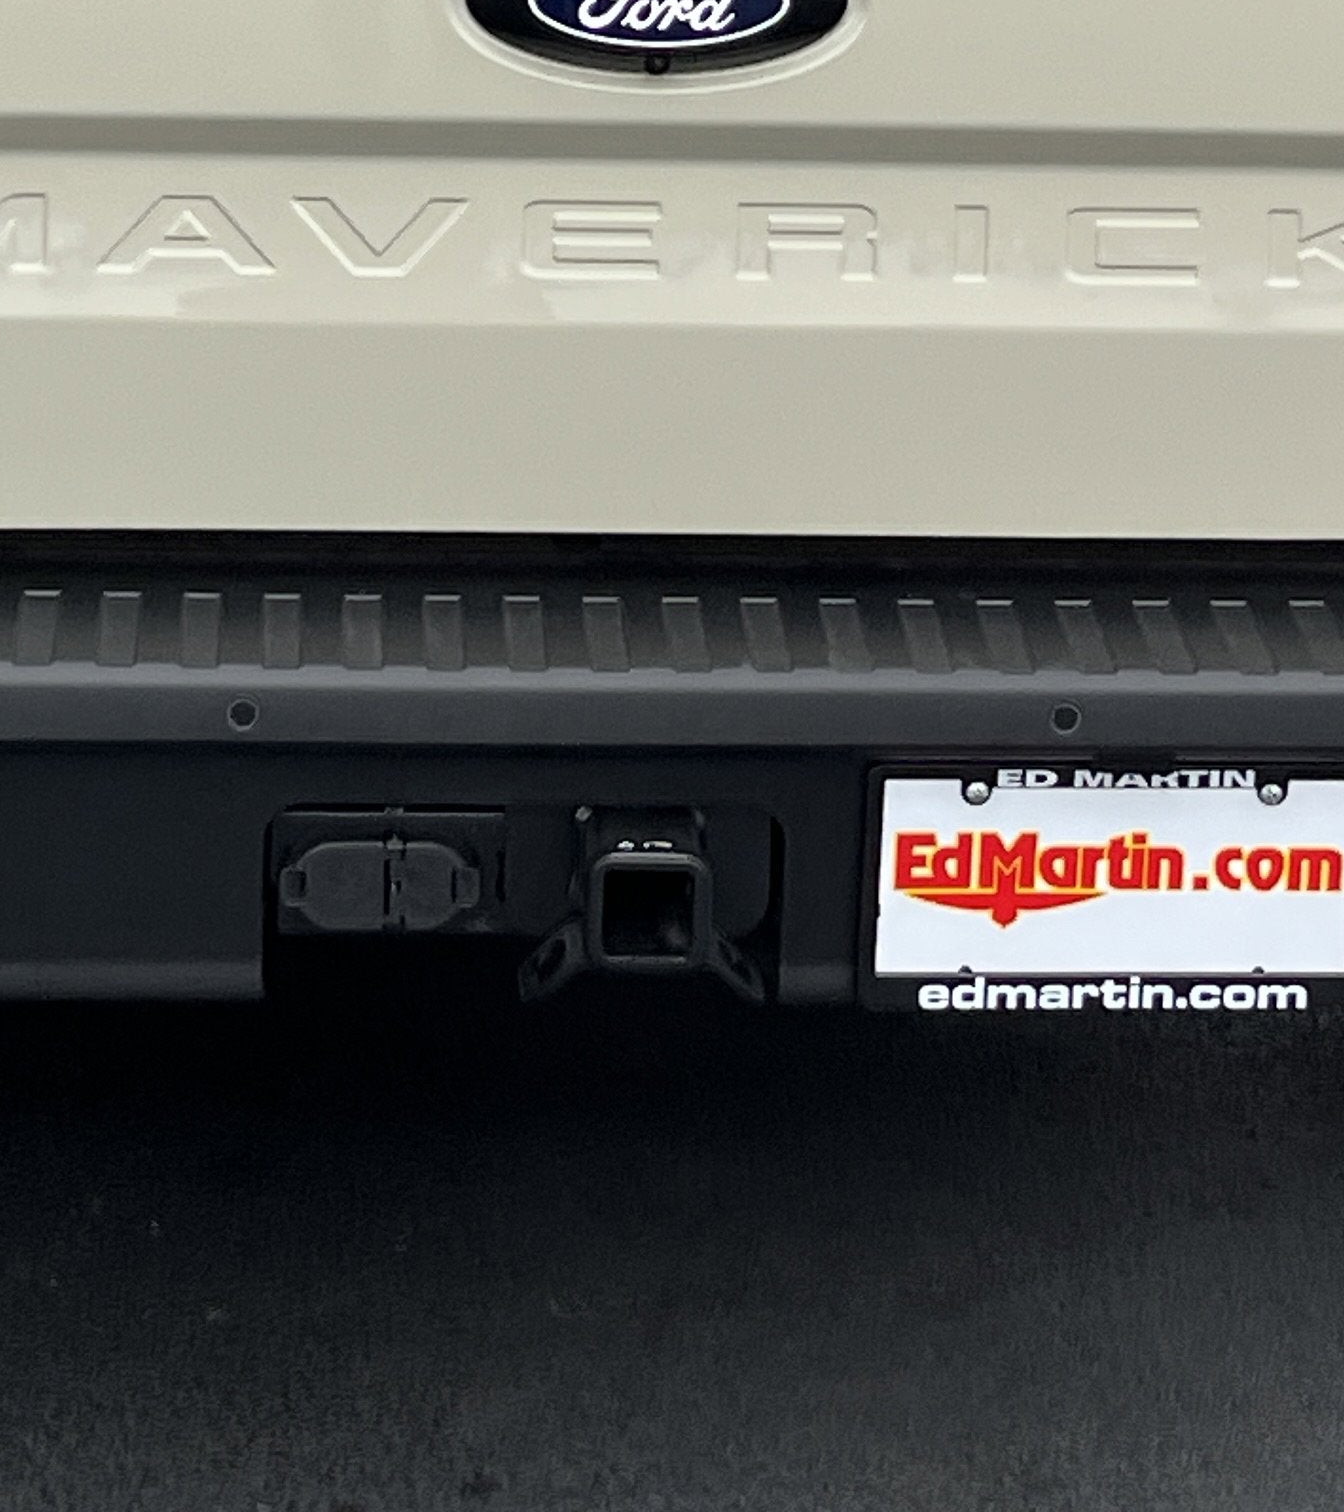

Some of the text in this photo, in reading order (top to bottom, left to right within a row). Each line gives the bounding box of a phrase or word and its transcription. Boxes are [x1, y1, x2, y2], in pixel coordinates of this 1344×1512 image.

[997, 769, 1256, 788] ED MARTIN
[894, 831, 1343, 891] EdMartin.com
[918, 977, 1308, 1010] edmartin.com
